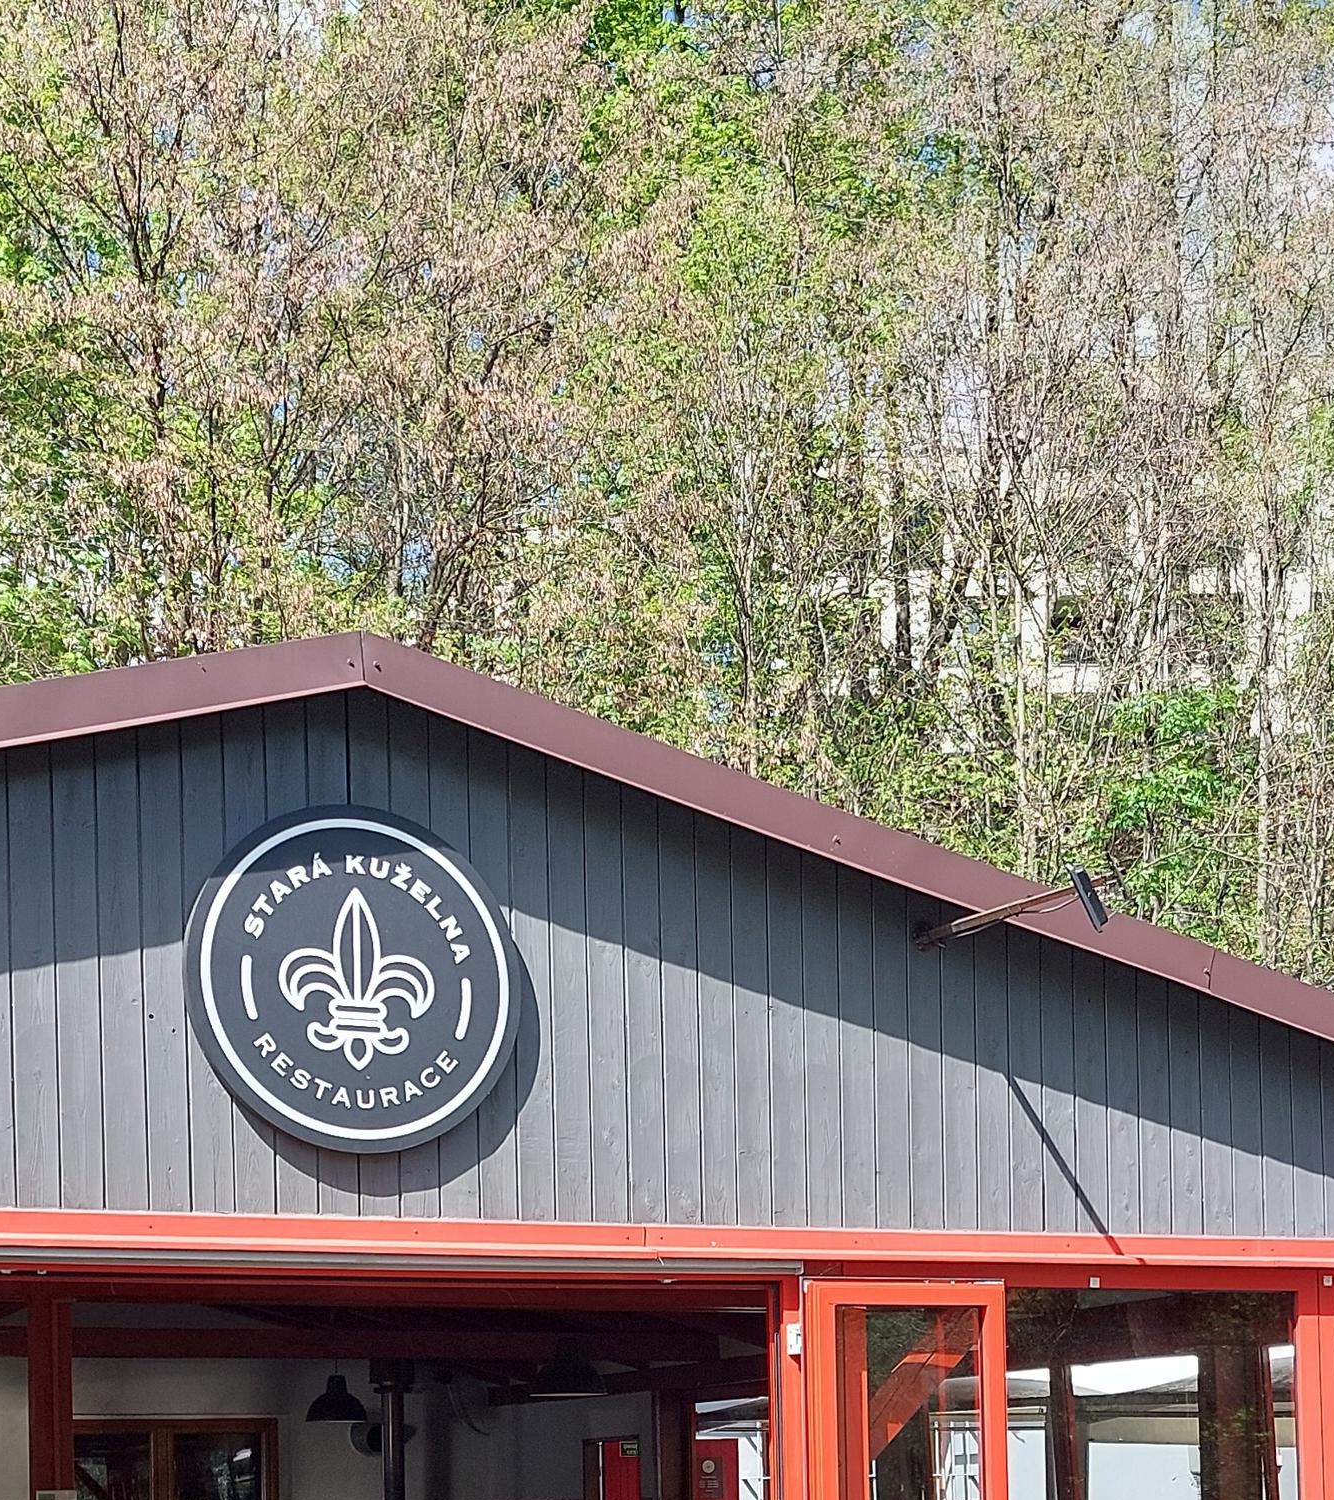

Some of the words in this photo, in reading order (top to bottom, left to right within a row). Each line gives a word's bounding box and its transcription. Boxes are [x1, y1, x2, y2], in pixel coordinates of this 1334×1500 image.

[244, 852, 333, 938] STARÁ
[345, 854, 471, 964] KUŽELNA
[253, 1033, 458, 1110] RESTAURACE
